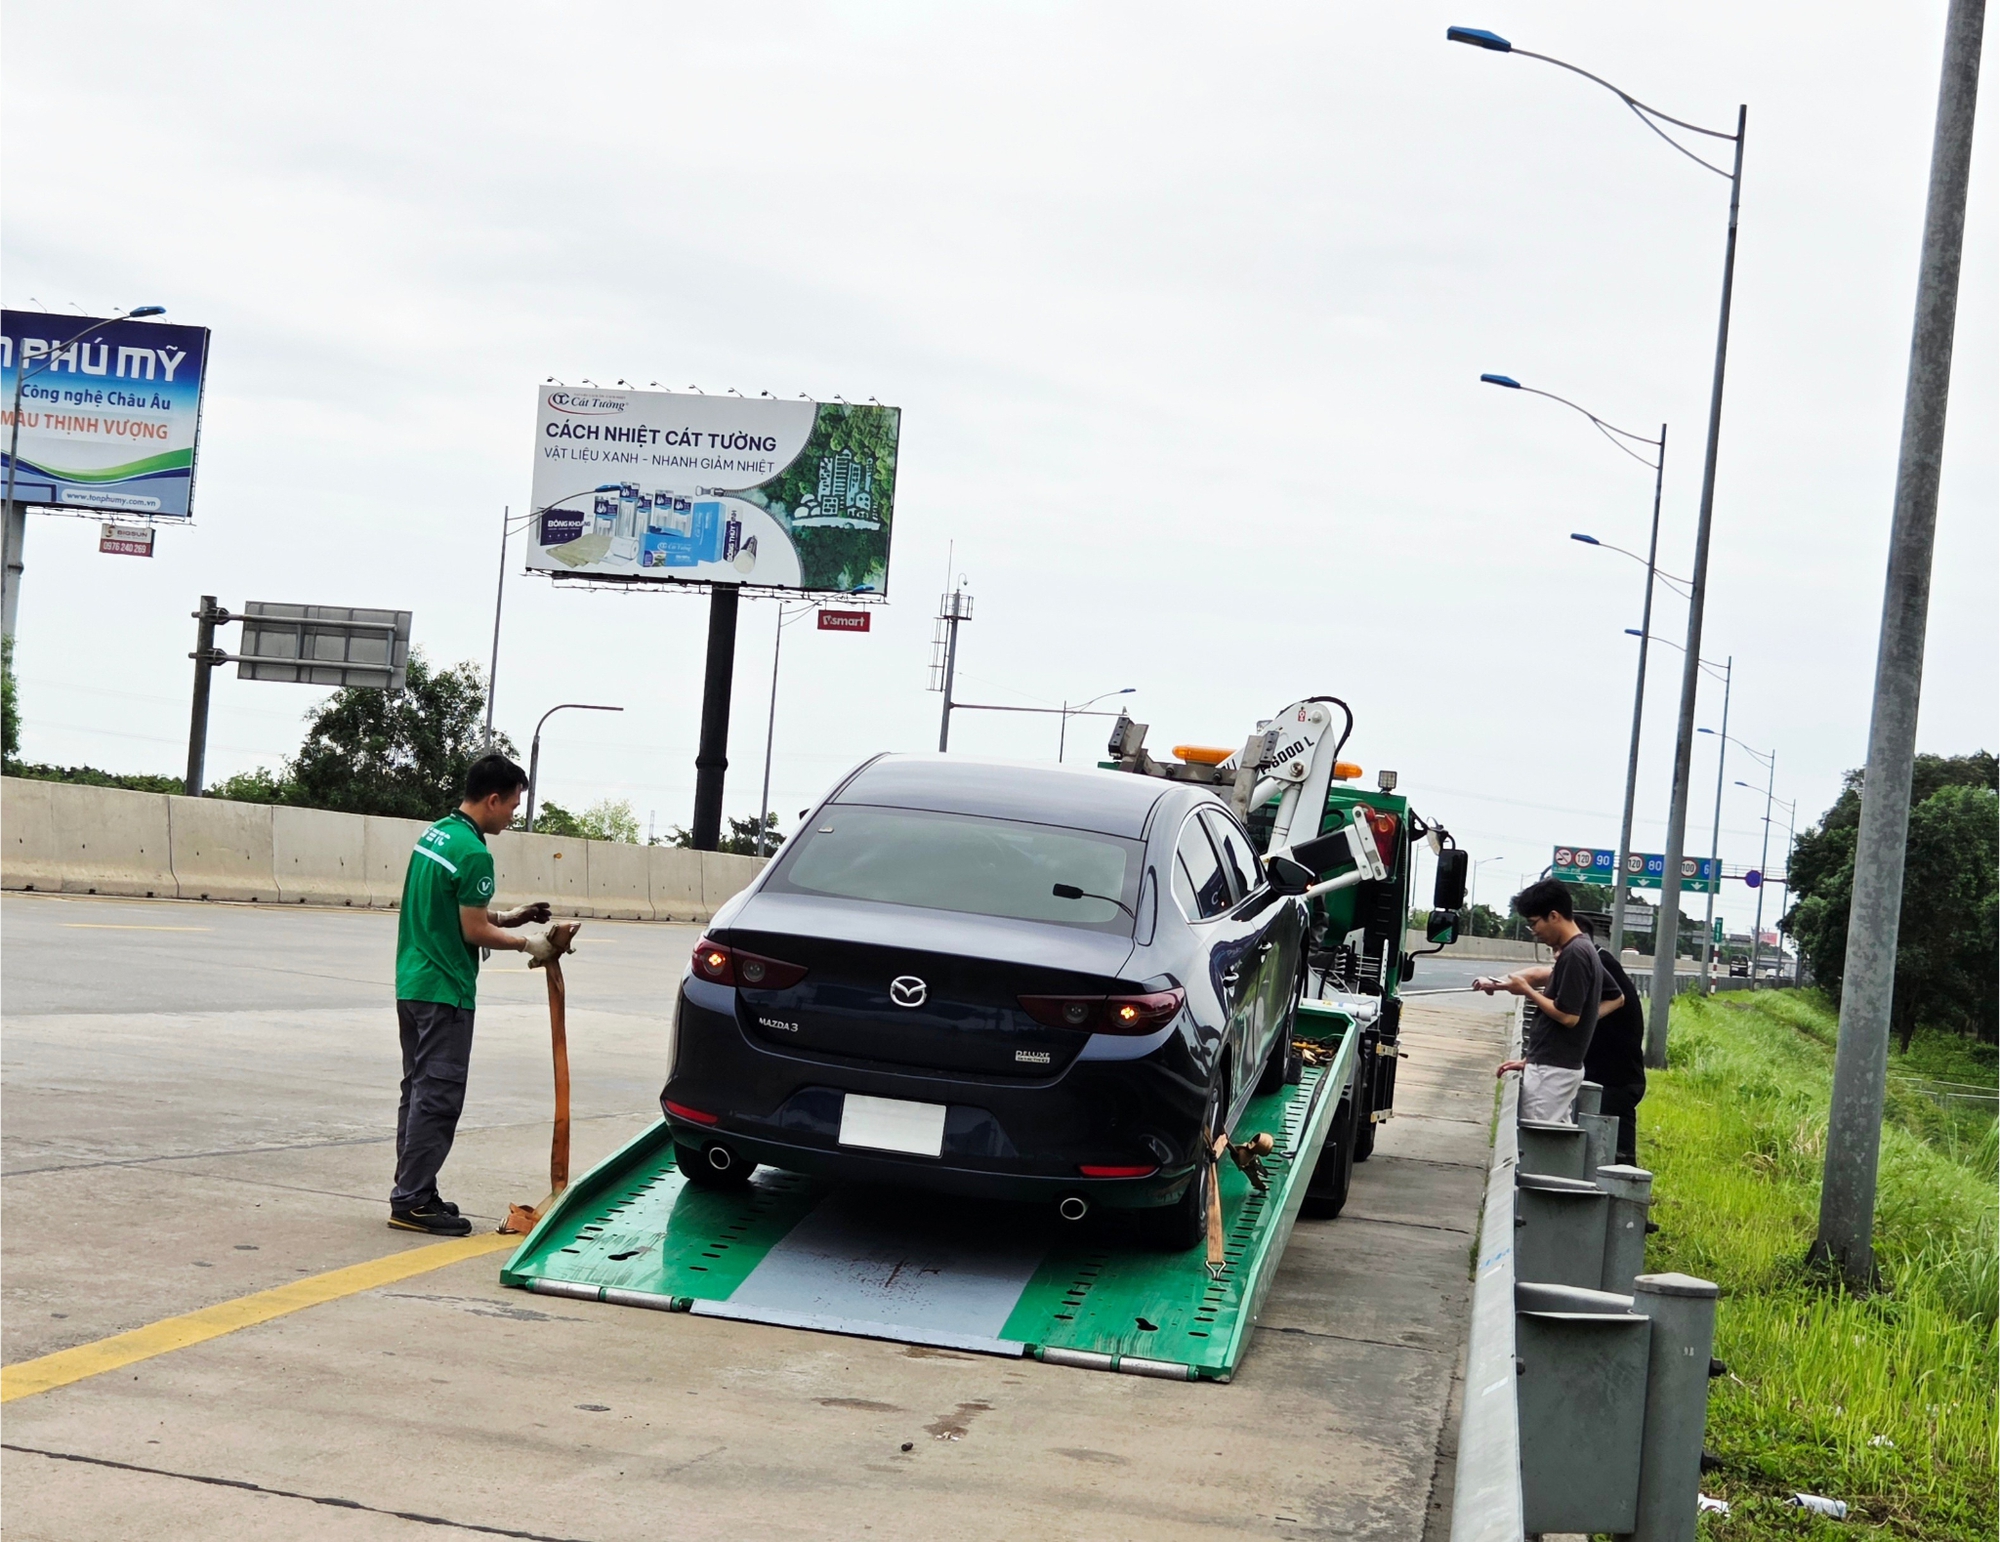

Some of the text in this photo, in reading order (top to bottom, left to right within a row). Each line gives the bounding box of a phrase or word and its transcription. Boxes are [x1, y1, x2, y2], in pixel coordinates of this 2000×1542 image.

[23, 337, 109, 376] PHÚ
[21, 384, 171, 410] Công nghệ Châu Âu
[44, 413, 99, 435] THỊNH
[103, 418, 168, 441] VƯỢNG
[545, 419, 777, 452] CÁCH NHIỆT CÁT TƯỜNG
[544, 446, 567, 460] VẬT
[571, 448, 599, 462] LIỆU
[602, 451, 639, 464] XANH
[652, 455, 697, 469] NHANH
[700, 456, 734, 471] GIẢM
[736, 460, 775, 474] NHIỆT
[66, 492, 156, 507] www.tonphumy.com.vn
[1577, 854, 1610, 866] 120 90
[1647, 860, 1662, 872] 80
[759, 1017, 799, 1033] MAZDA 3
